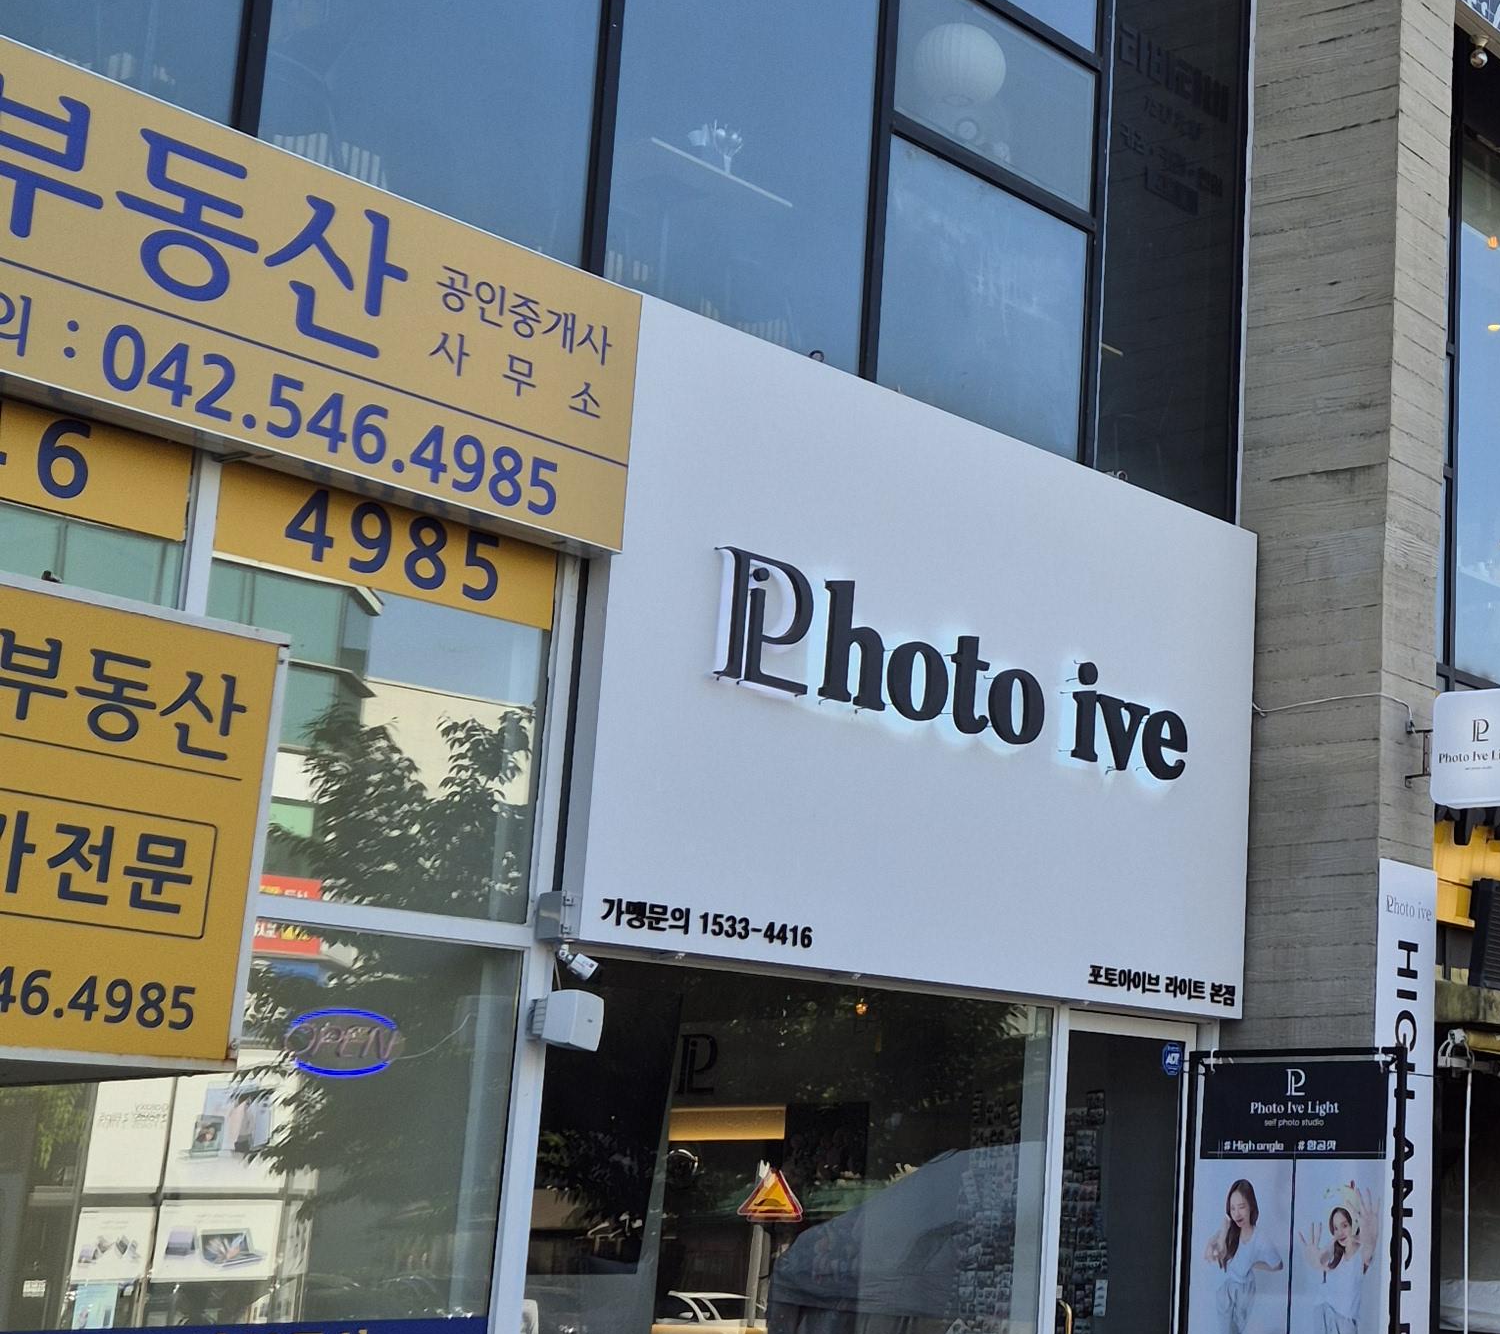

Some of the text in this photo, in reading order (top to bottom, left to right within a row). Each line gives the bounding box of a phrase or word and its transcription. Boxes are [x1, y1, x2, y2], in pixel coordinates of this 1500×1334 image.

[436, 265, 612, 367] 공인중개사
[103, 323, 559, 517] 042.546.4985
[284, 488, 500, 601] 4985
[1069, 661, 1189, 781] ive
[1438, 752, 1470, 764] Photo
[1472, 749, 1488, 762] Ive
[601, 898, 813, 950] 가맹문의 1533-4416
[1088, 964, 1236, 1007] 포토아이브 라이트 본점
[1250, 1100, 1340, 1116] Photo Ive Light
[1264, 1118, 1325, 1128] self photo studio
